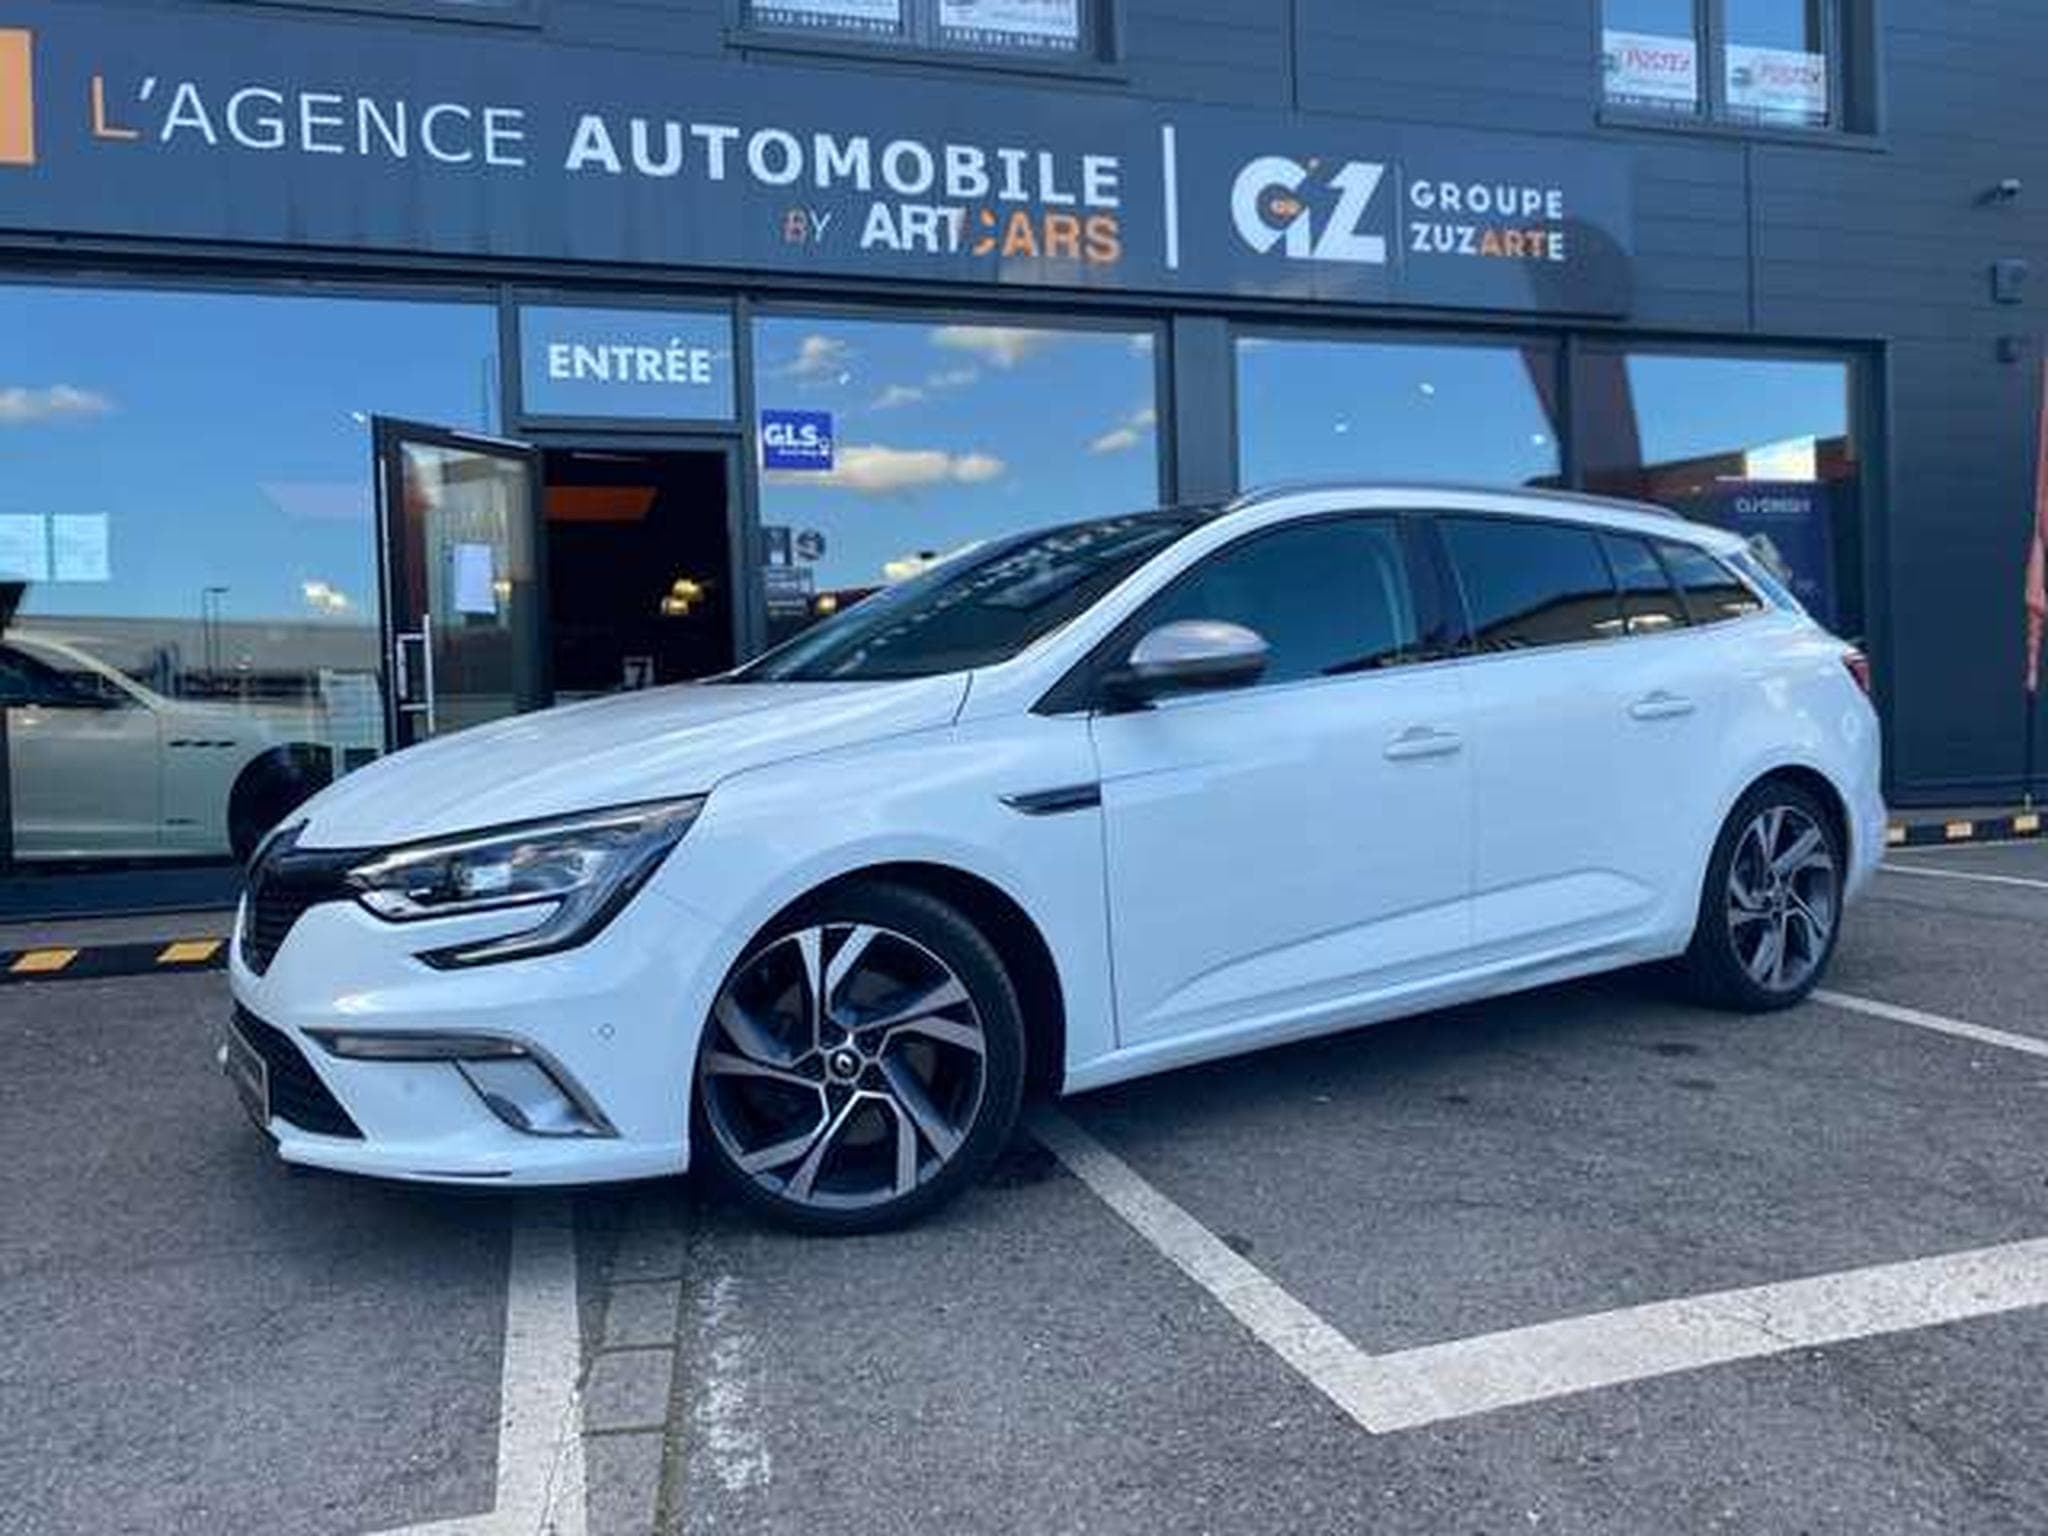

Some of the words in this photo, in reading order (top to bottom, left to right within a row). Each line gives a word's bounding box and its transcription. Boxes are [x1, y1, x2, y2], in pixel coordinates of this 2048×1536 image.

[564, 114, 1121, 207] AUTOMOBILE
[1410, 180, 1564, 219] GROUPE
[1411, 223, 1565, 261] ZUZARTE
[548, 337, 711, 383] ENTRÉE
[764, 422, 818, 446] GLS
